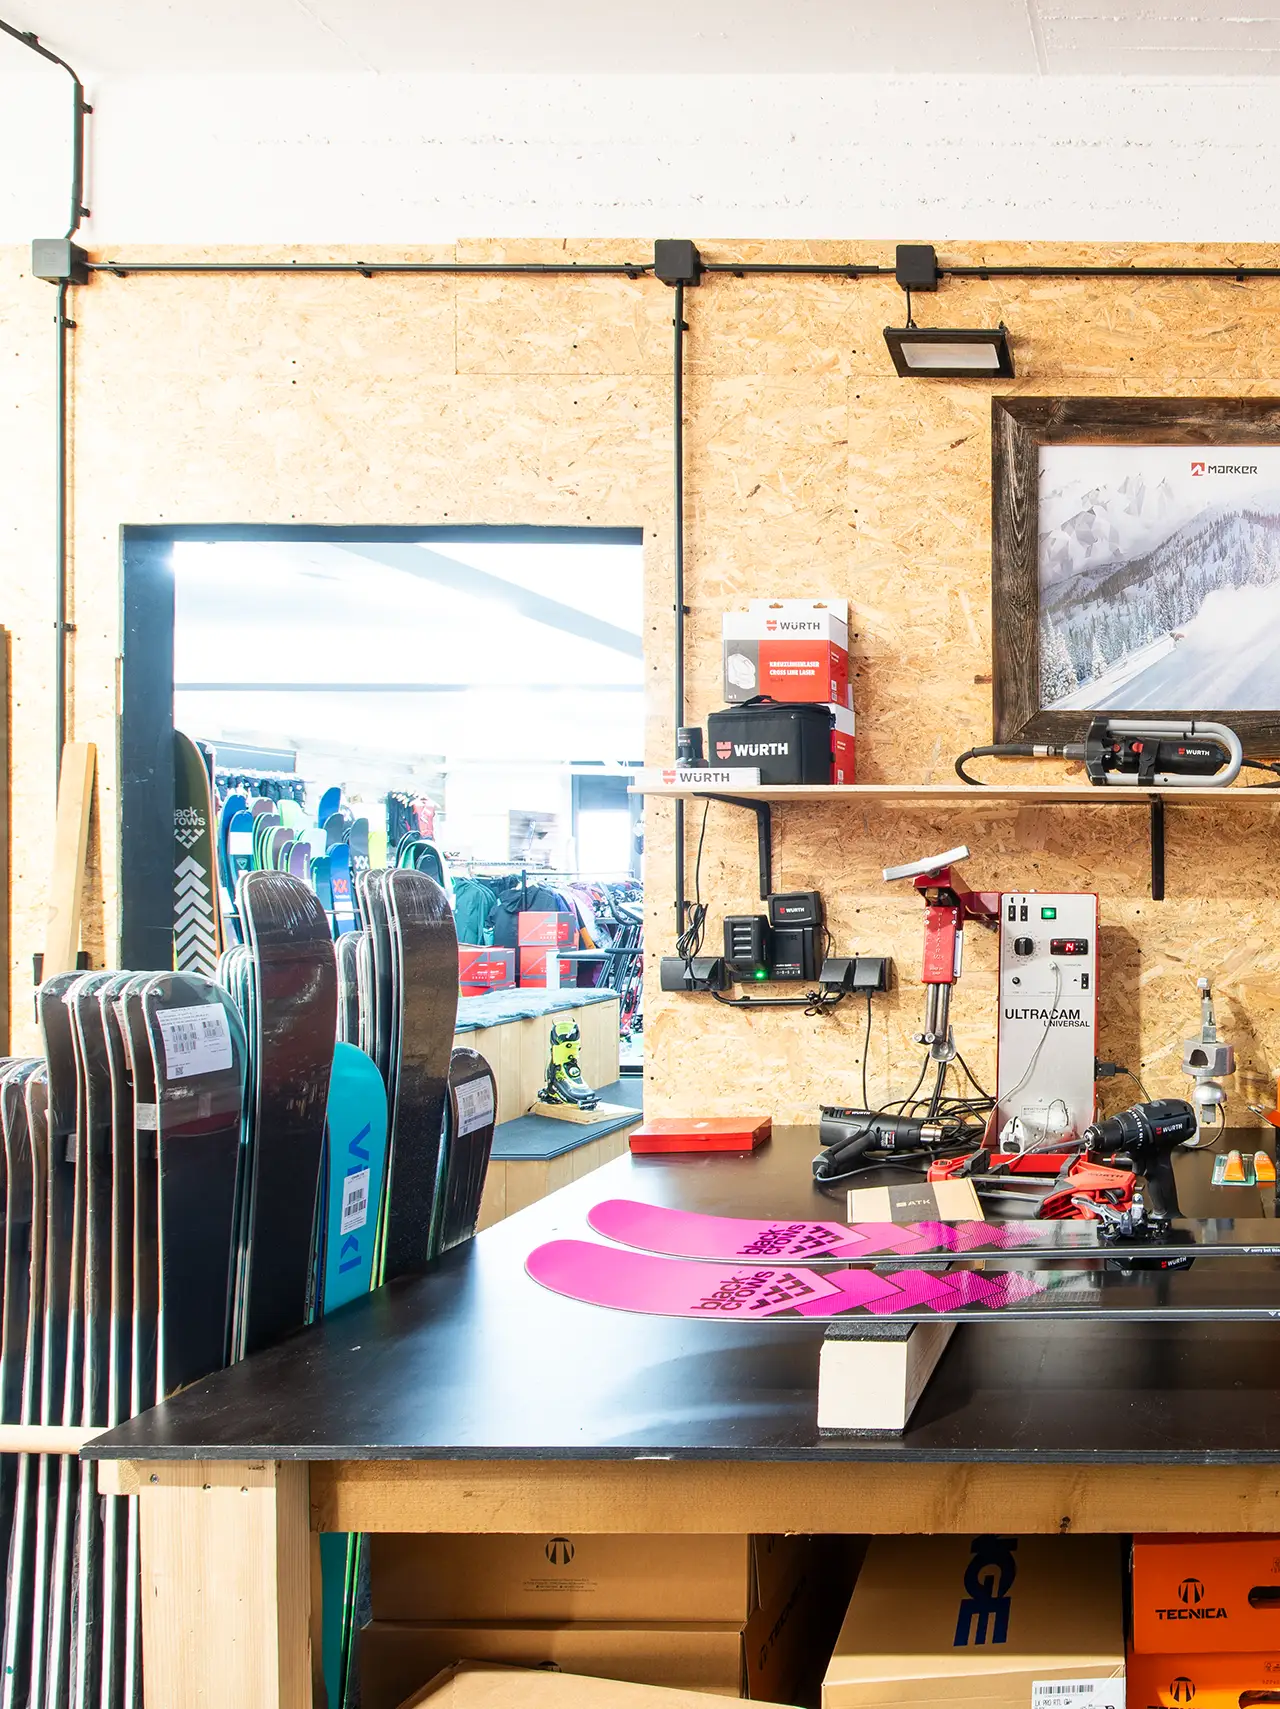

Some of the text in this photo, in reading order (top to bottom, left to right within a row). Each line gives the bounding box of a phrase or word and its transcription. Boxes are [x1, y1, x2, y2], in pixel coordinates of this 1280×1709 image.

[1208, 465, 1258, 475] MARKER
[780, 621, 821, 631] WÜRTH
[734, 742, 789, 757] WÜRTH
[680, 772, 730, 783] WÜRTH
[173, 817, 206, 826] rows
[1005, 1008, 1081, 1020] ULTRACAM
[1043, 1020, 1091, 1028] UNIVERSAL
[908, 1199, 931, 1207] ATK
[736, 1228, 785, 1255] black
[762, 1224, 807, 1256] crows
[690, 1276, 751, 1310] black
[720, 1271, 776, 1311] crows
[1155, 1607, 1228, 1620] TECNICA
